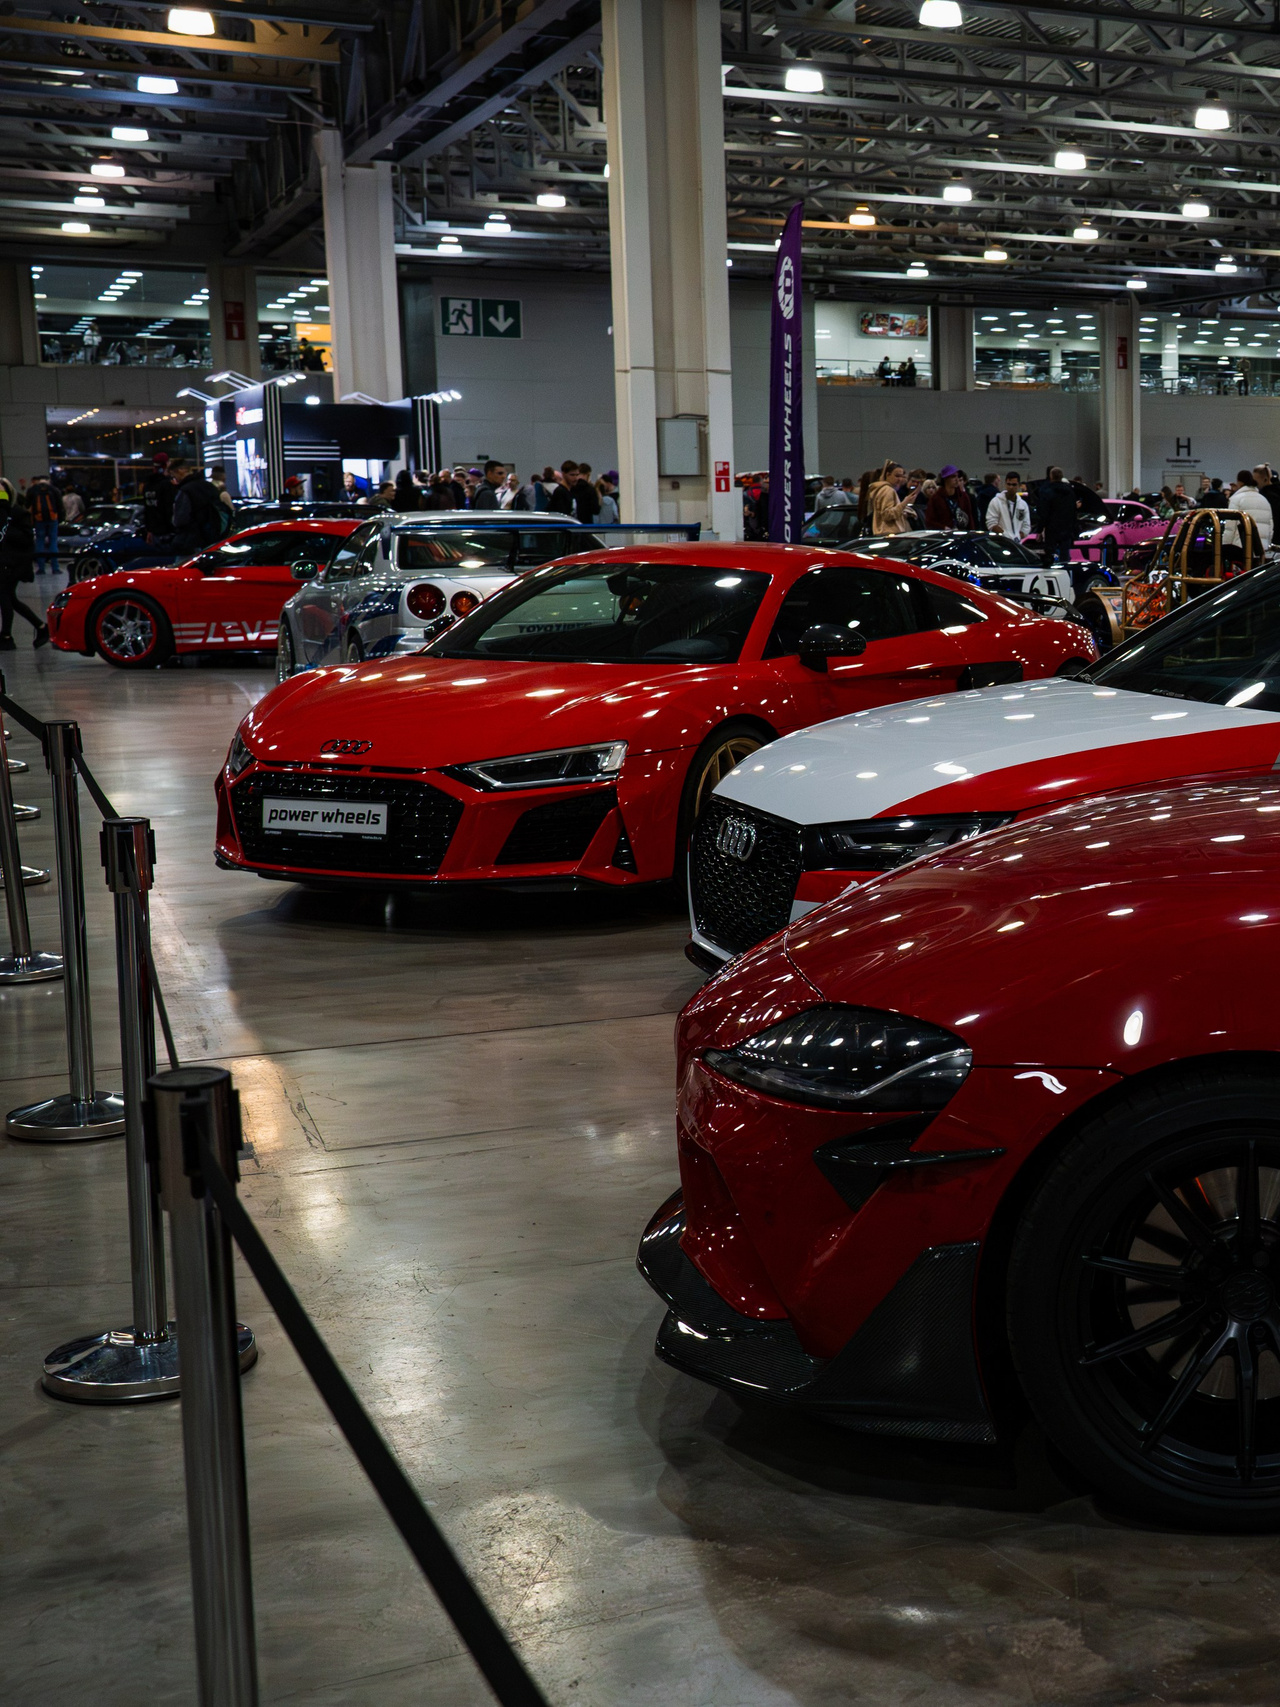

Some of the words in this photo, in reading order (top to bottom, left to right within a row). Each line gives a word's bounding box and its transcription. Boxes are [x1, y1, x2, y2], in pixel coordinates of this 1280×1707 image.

[783, 332, 792, 452] WHEELS
[985, 434, 1032, 455] HJK
[1176, 437, 1191, 456] H
[267, 808, 319, 824] power
[320, 808, 382, 825] wheels
